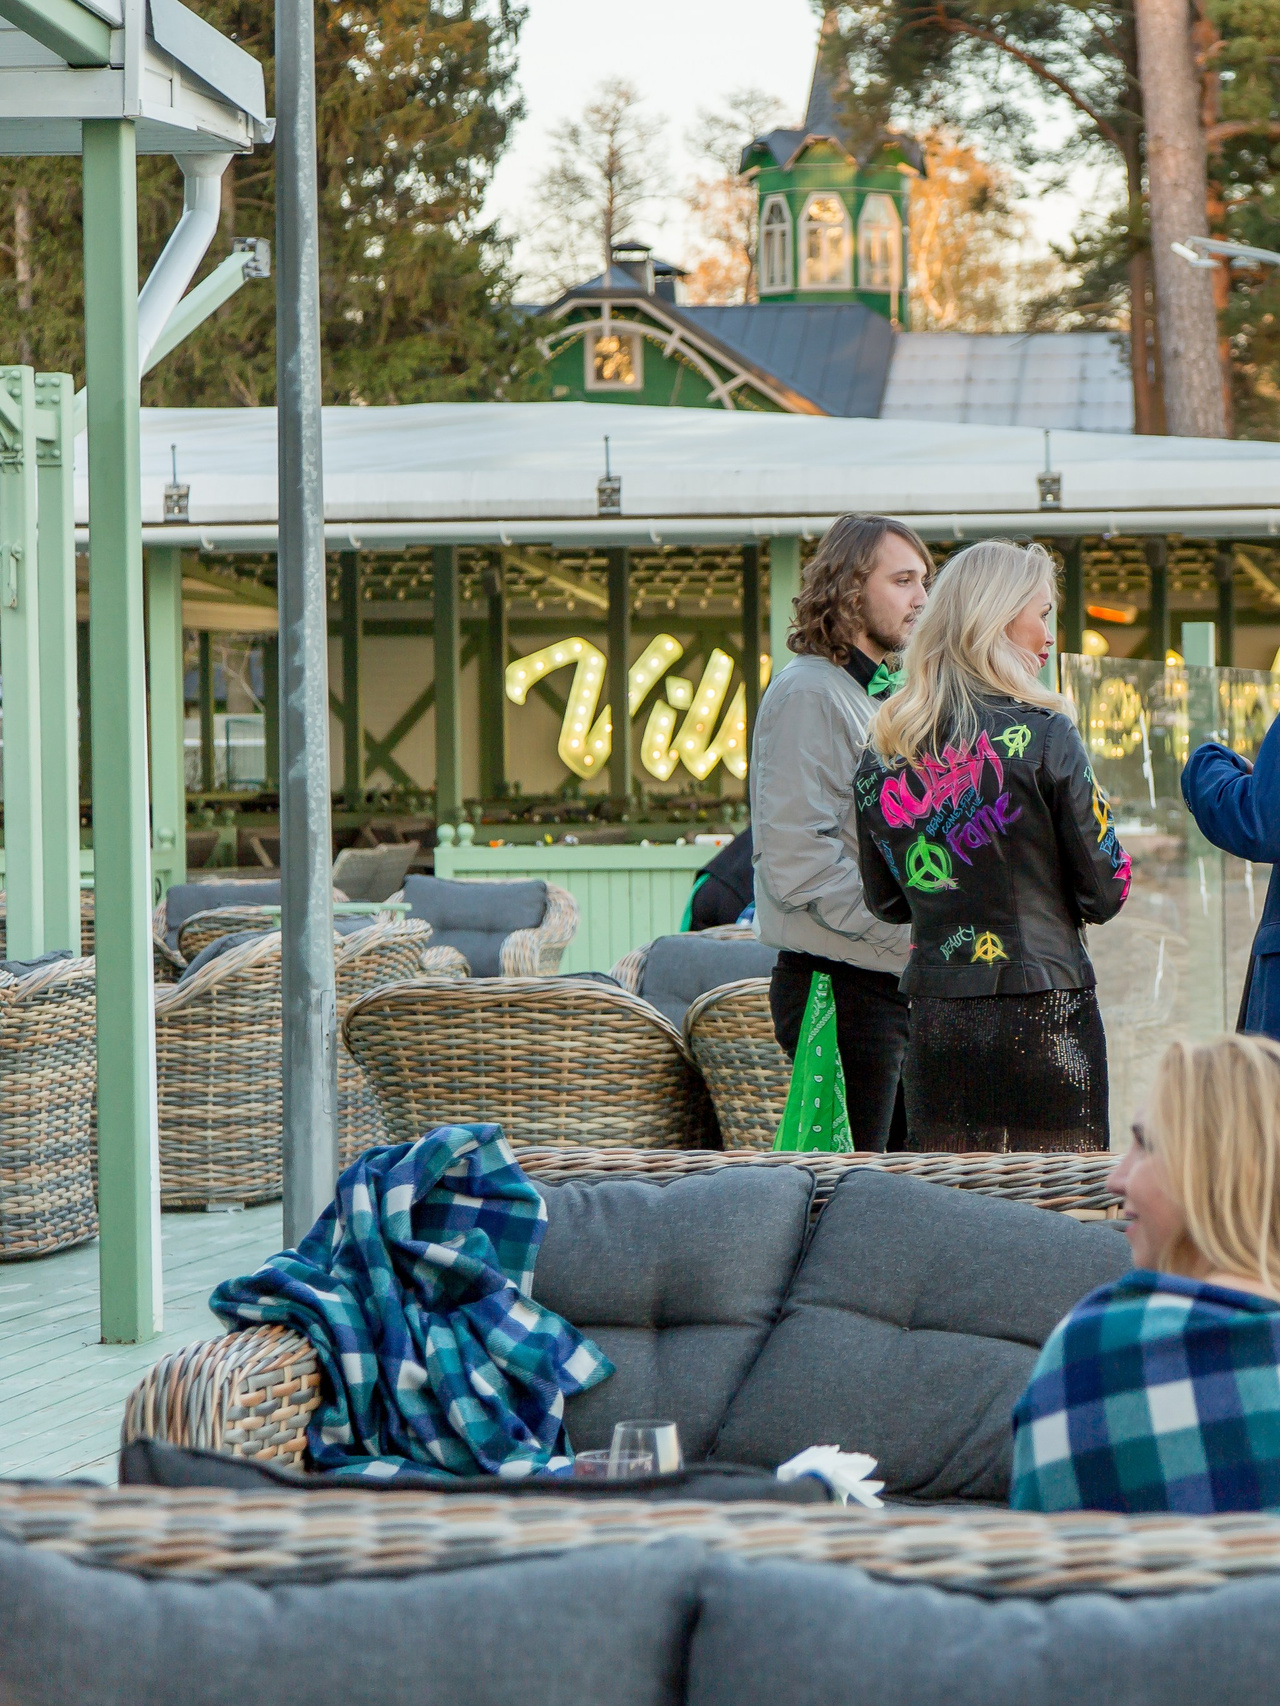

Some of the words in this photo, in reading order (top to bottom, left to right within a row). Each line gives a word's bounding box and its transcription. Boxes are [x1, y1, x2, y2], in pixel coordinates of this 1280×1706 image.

[880, 729, 1004, 830] QUEEN
[925, 798, 953, 837] BEAUTY
[965, 796, 984, 818] LOVE
